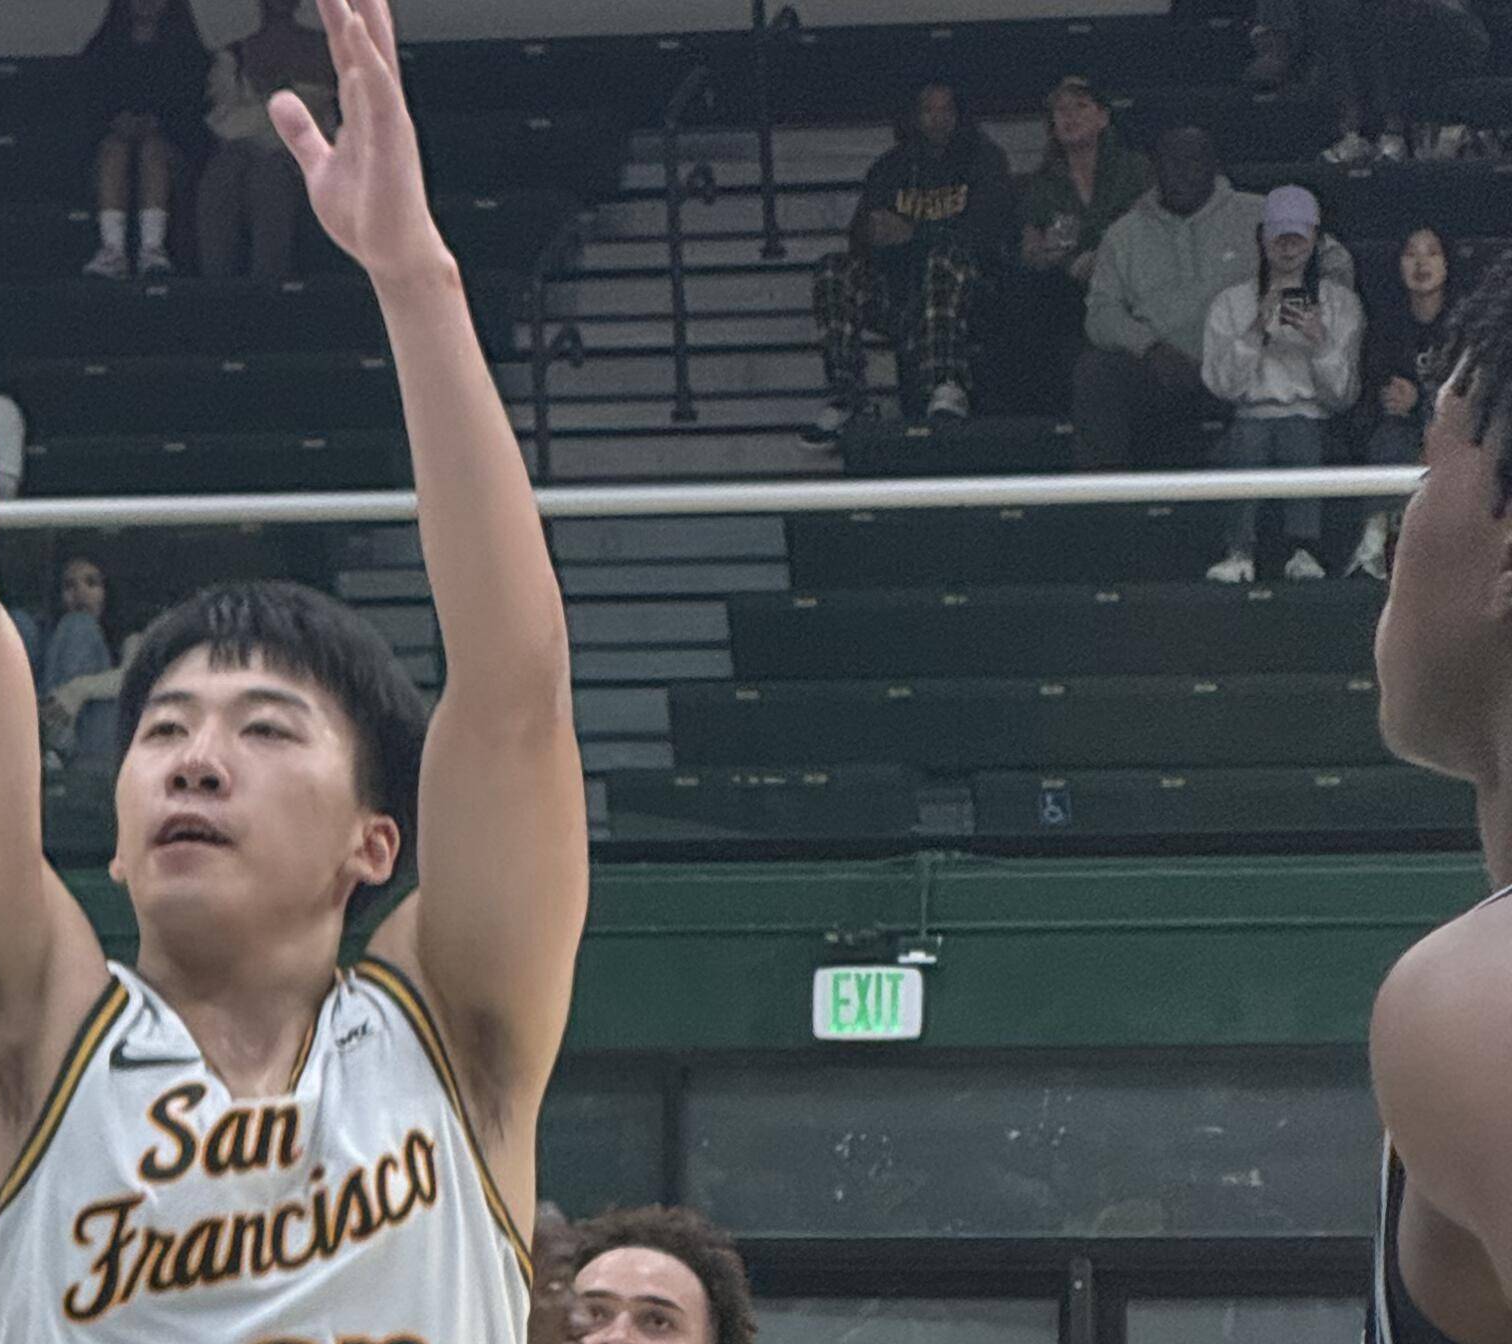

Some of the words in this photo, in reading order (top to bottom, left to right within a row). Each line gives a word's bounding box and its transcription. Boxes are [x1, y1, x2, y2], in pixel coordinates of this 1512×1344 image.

[831, 971, 905, 1033] EXIT
[137, 1080, 301, 1184] San
[62, 1128, 438, 1323] Francisco
